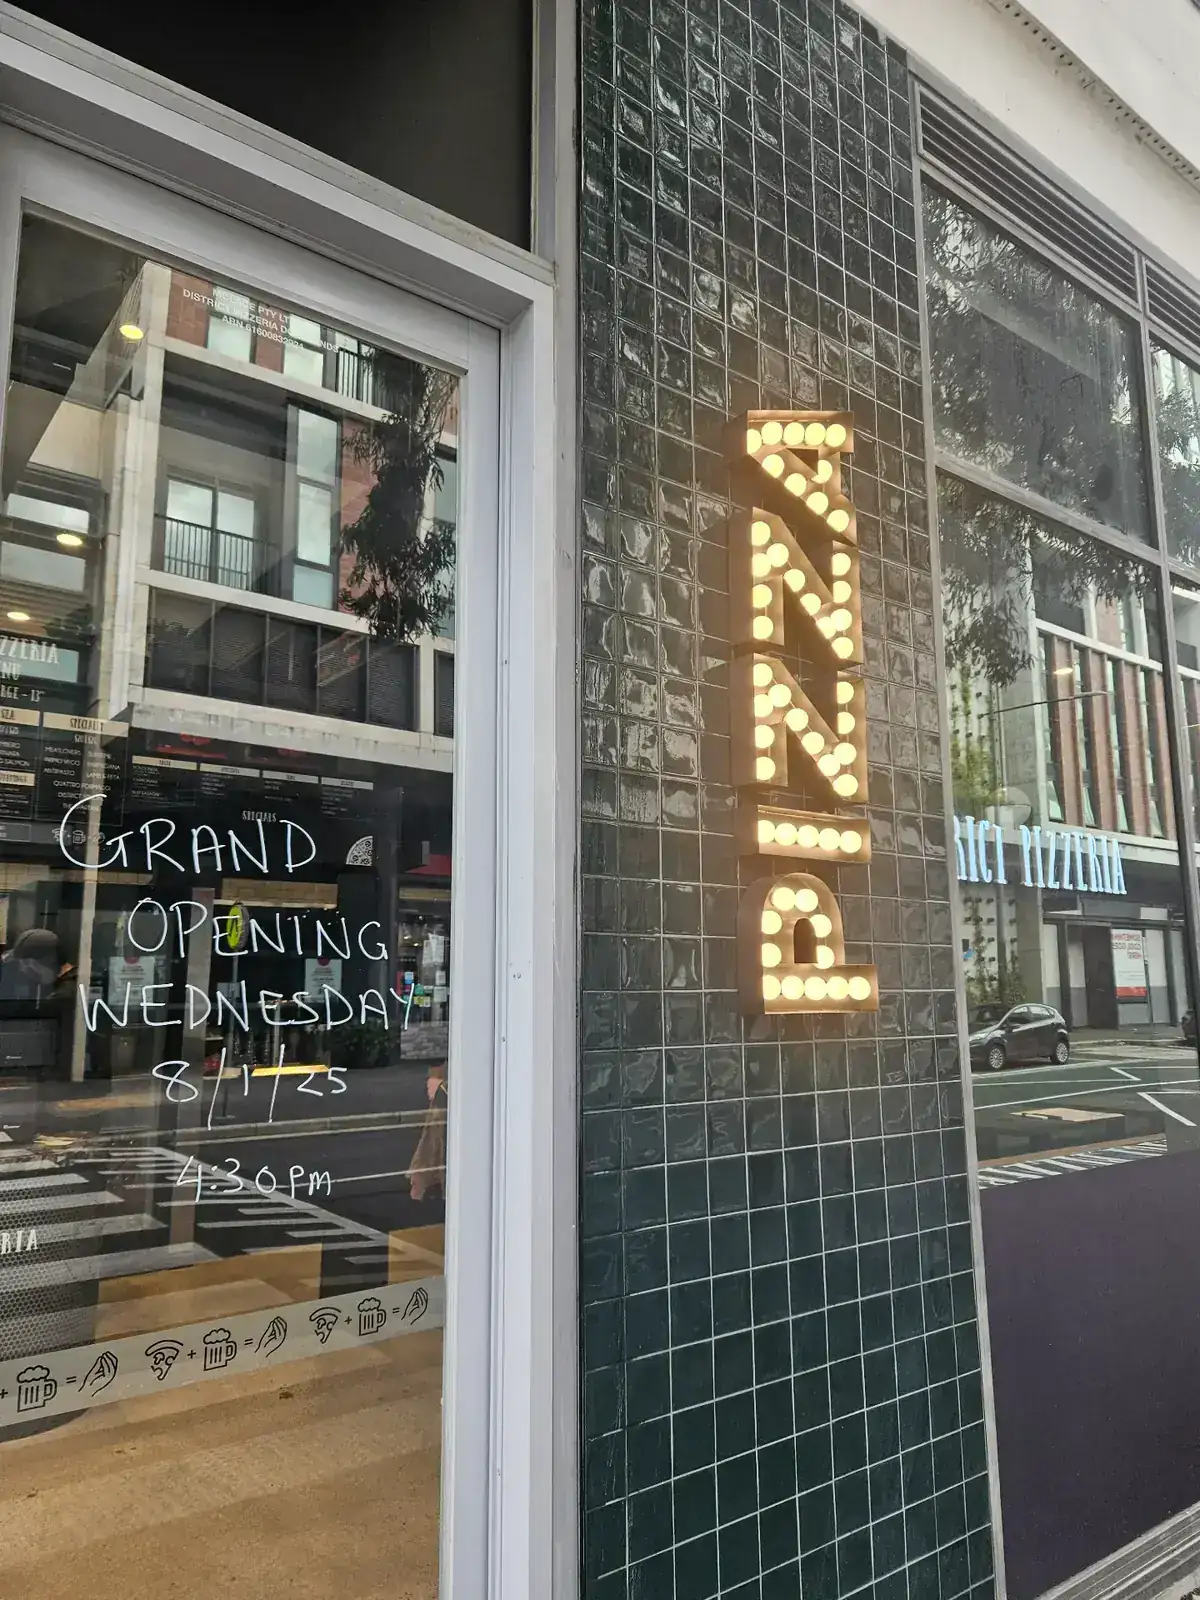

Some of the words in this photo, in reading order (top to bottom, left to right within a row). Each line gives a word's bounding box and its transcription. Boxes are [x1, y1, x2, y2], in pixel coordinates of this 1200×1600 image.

[221, 314, 244, 329] ABN
[258, 305, 276, 319] PTY
[745, 408, 879, 1015] PIZZA
[60, 794, 316, 874] GRAND
[242, 810, 277, 823] SPECIALS
[1019, 824, 1127, 895] PIZZERIA
[127, 897, 389, 960] OPENING
[78, 979, 415, 1032] WEDNESDAY
[152, 1043, 348, 1131] 8/1/25
